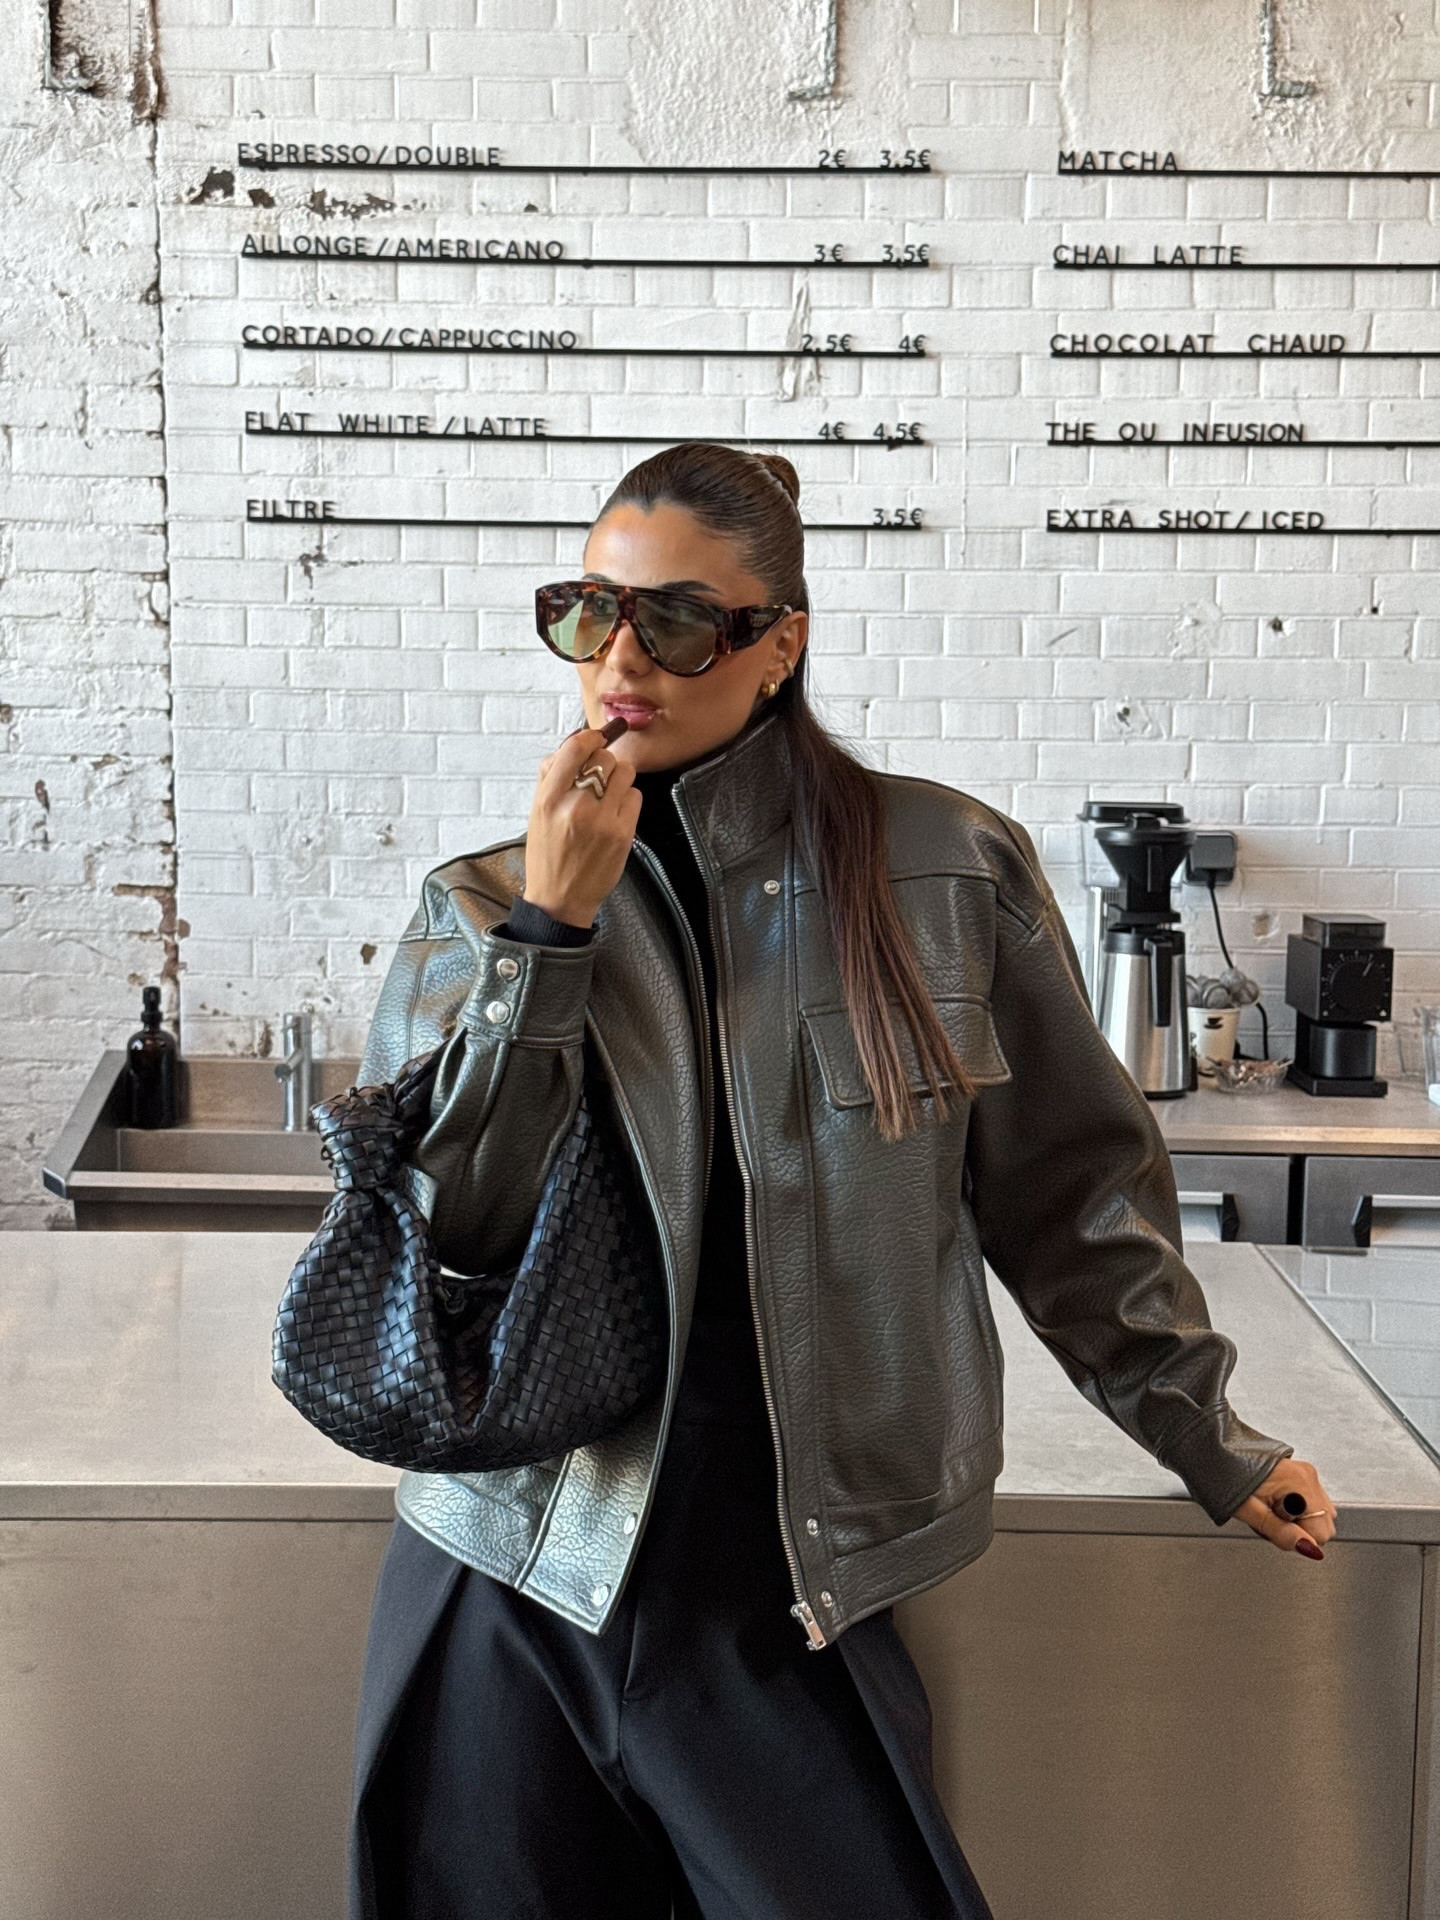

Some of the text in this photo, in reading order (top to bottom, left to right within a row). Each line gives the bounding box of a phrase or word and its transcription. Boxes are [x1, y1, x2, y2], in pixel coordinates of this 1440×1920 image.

[238, 143, 501, 166] ESPRESSO/DOUBLE
[818, 149, 847, 168] 2€
[1058, 151, 1178, 171] MATCHA
[242, 234, 565, 260] ALLONGE/AMERICANO
[814, 244, 844, 262] 3€
[1053, 245, 1243, 265] CHAI LATTE
[242, 325, 577, 350] CORTADO/CAPPUCCINO
[899, 335, 926, 353] 4€
[1050, 334, 1346, 355] CHOCOLAT CHAUD
[246, 411, 310, 432] FLAT
[818, 422, 845, 440] 4€
[1046, 422, 1304, 442] THE OU INFUSION
[247, 500, 336, 519] FILTRE
[1047, 509, 1134, 529] EXTRA
